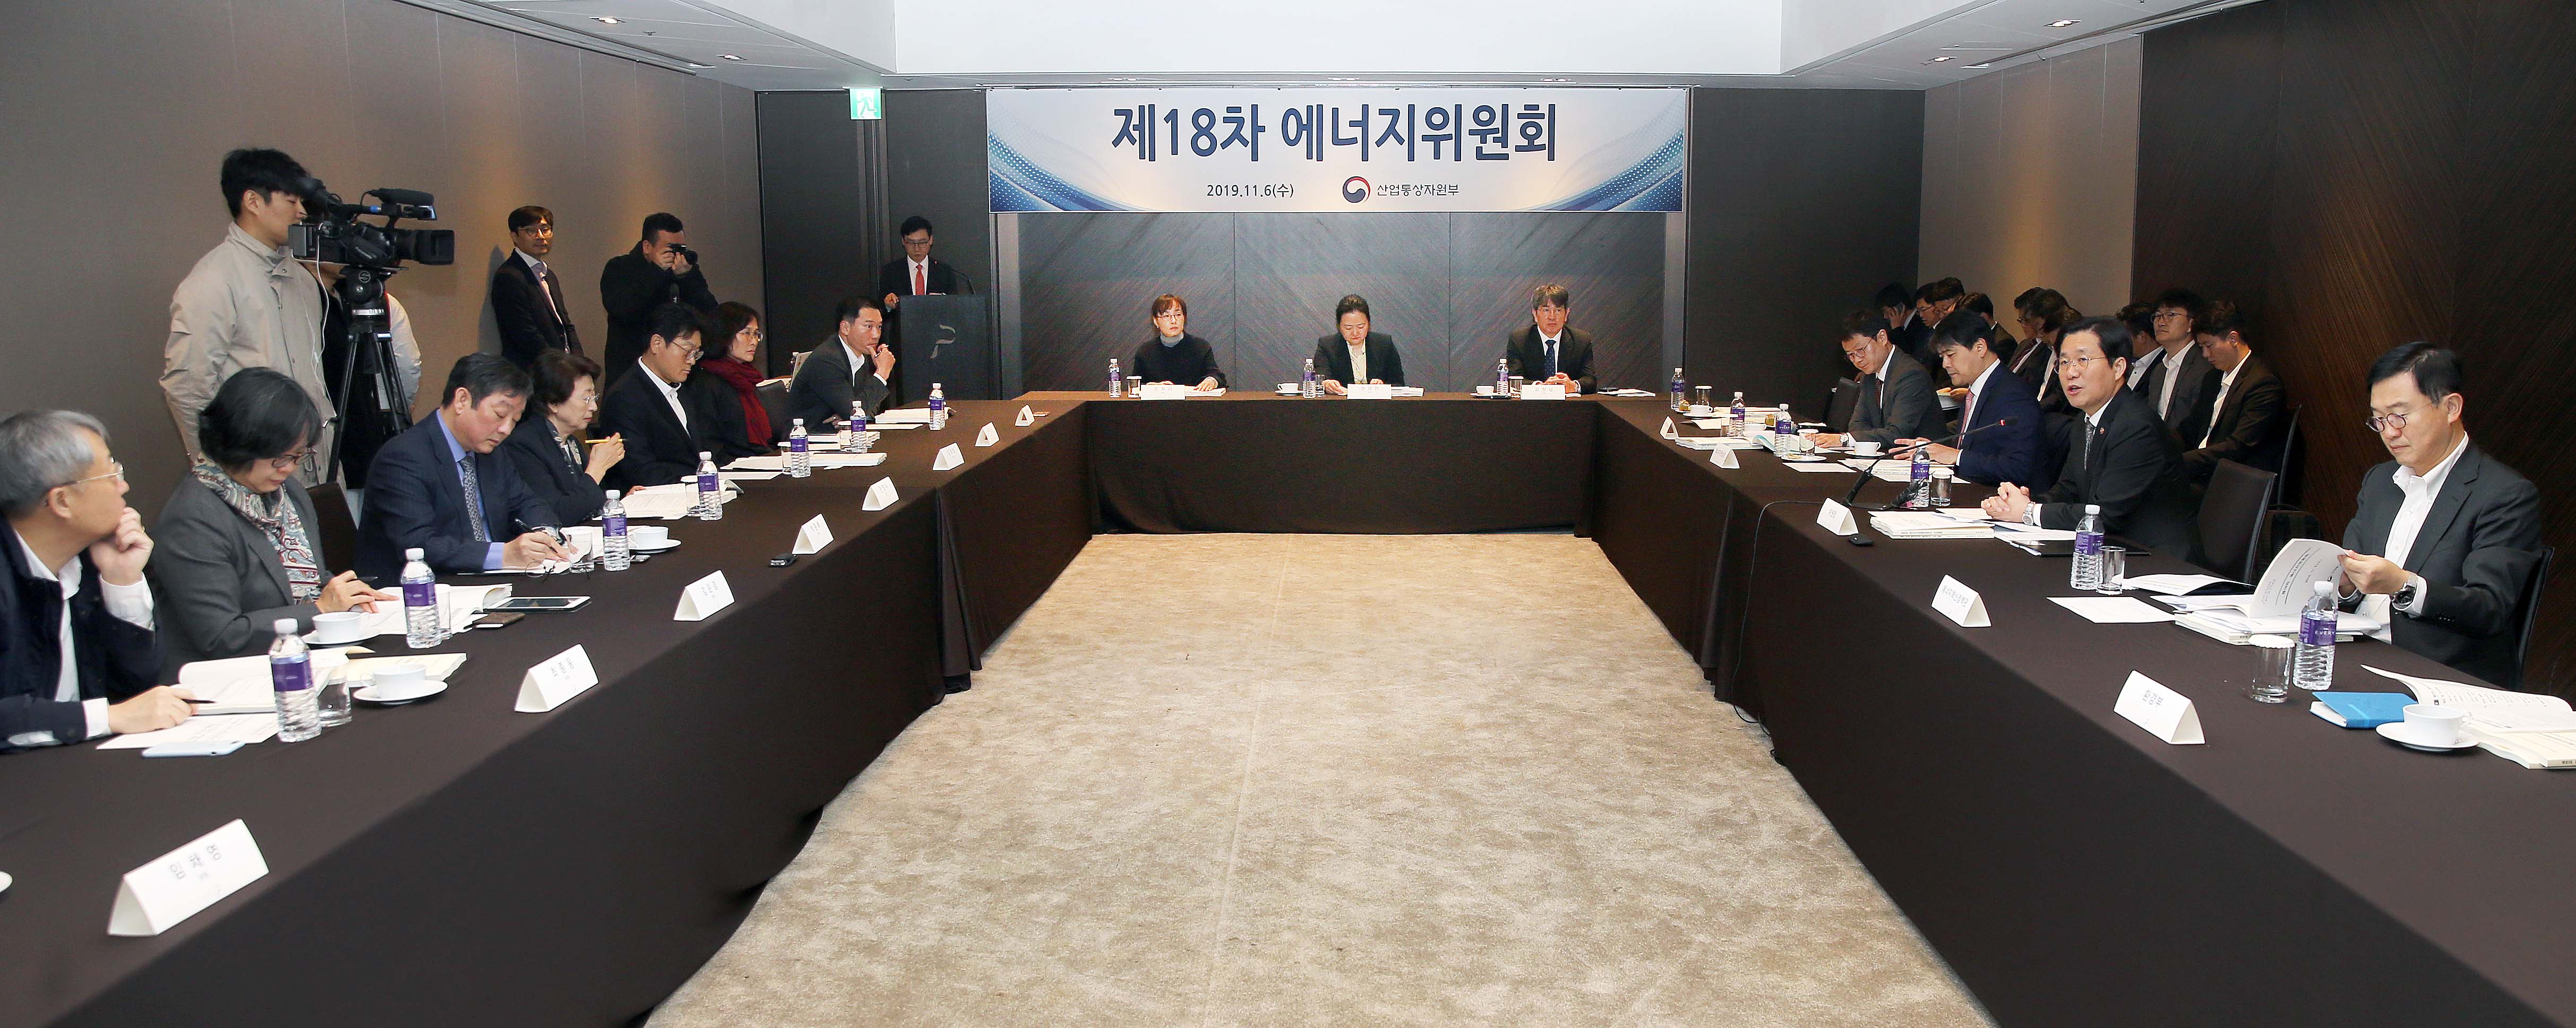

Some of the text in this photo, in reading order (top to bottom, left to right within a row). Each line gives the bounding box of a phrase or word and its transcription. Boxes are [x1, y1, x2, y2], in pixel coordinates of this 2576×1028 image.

[1112, 103, 1557, 162] 제18차 에너지위원회
[1206, 182, 1294, 200] 2019.11.6(수)
[1377, 183, 1459, 197] 산업통상자원부
